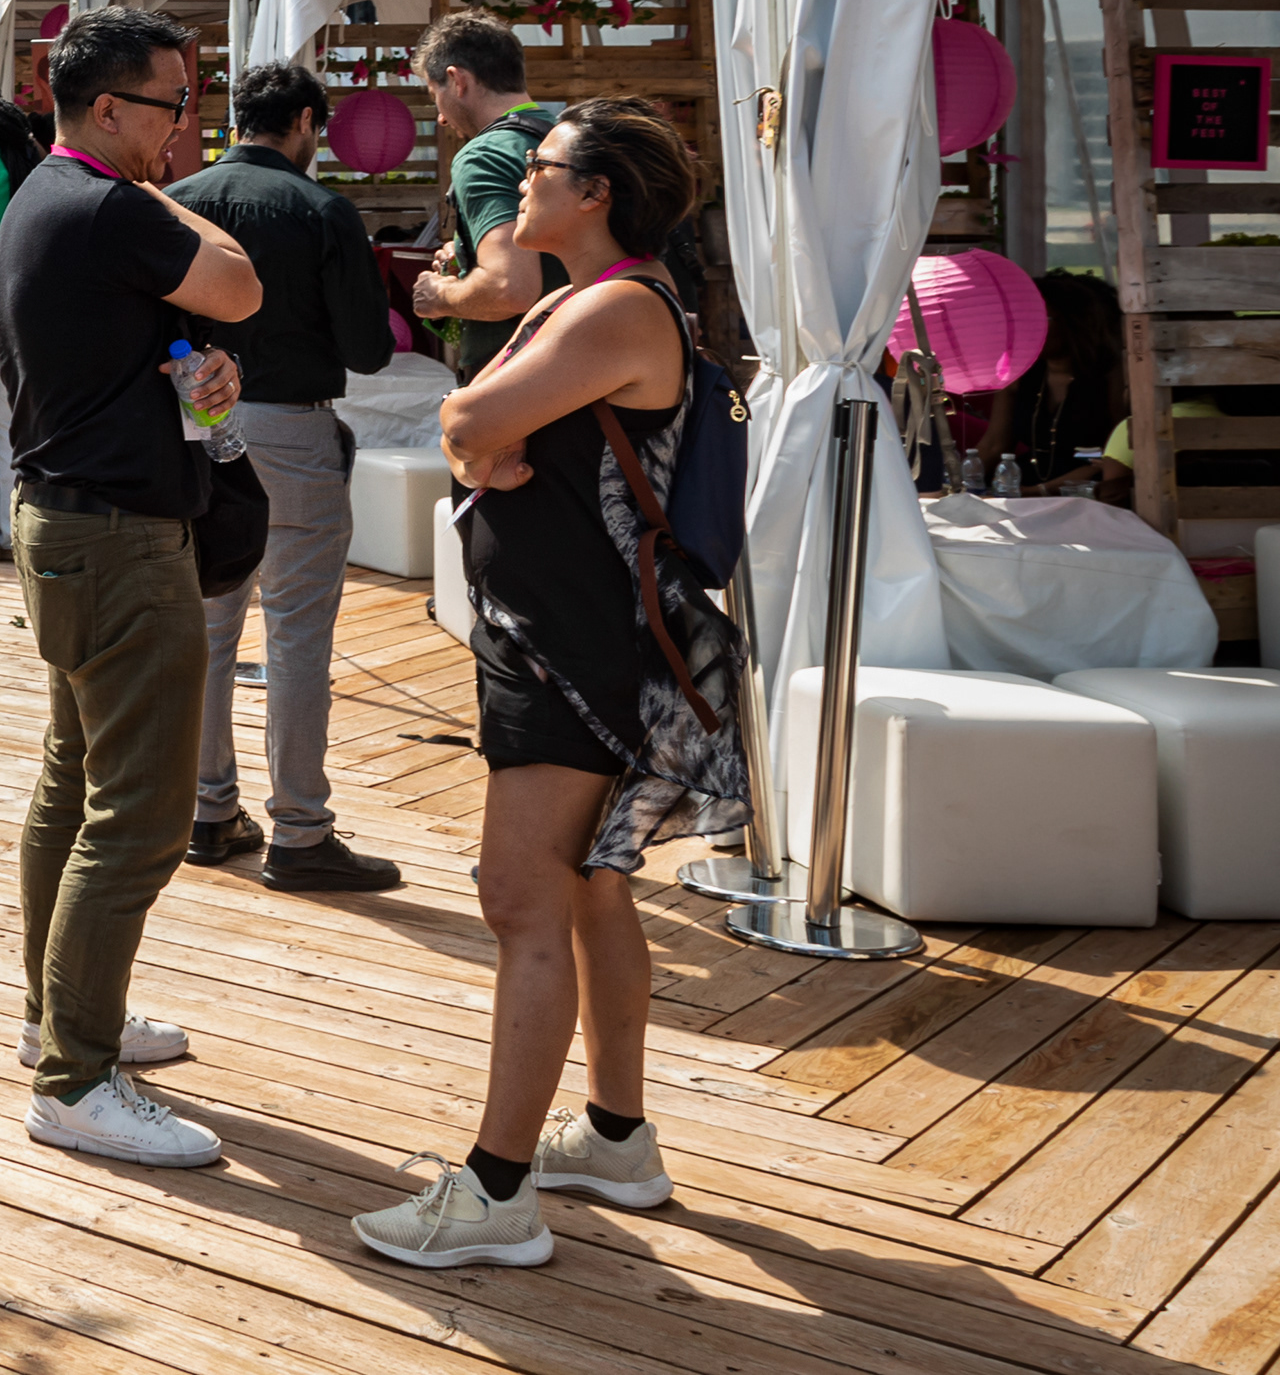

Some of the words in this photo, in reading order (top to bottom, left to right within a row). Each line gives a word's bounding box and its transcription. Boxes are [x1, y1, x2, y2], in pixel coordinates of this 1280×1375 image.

[1192, 88, 1227, 98] BEST
[1202, 102, 1218, 111] OF
[1196, 115, 1222, 125] THE
[1191, 129, 1225, 138] FEST
